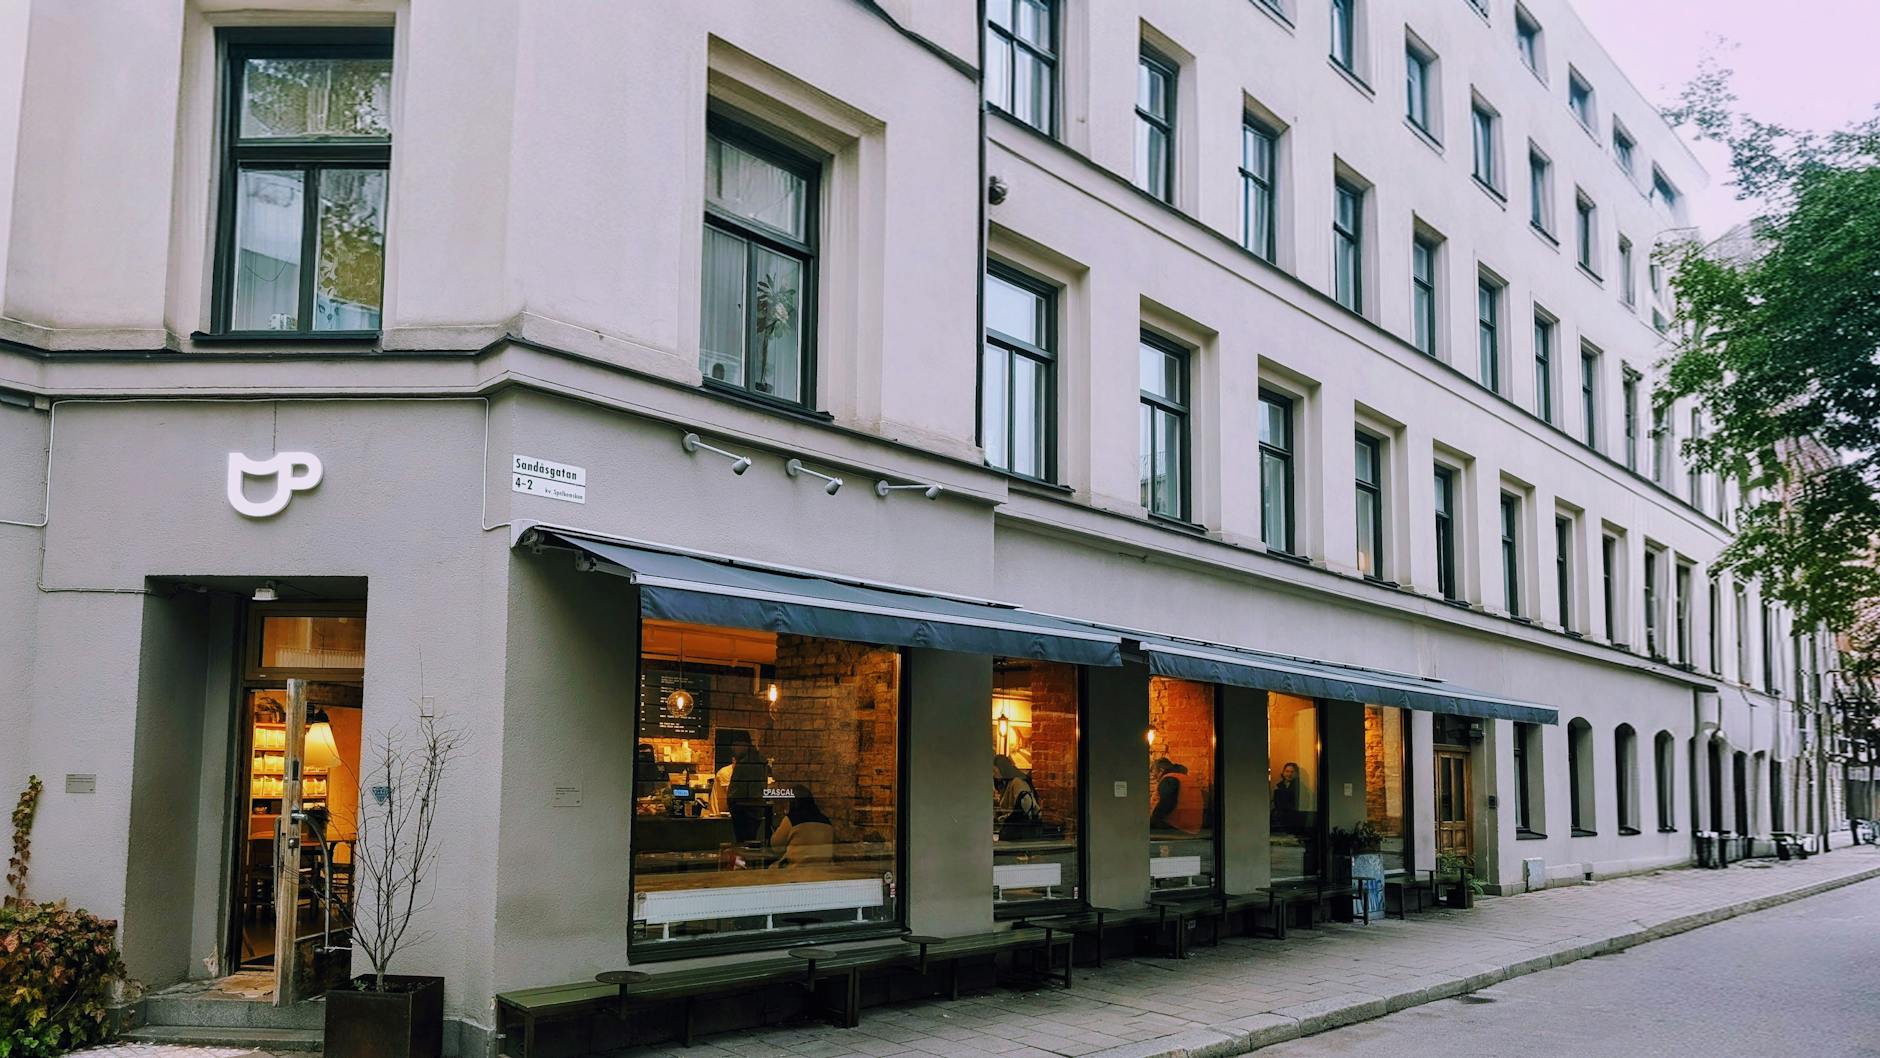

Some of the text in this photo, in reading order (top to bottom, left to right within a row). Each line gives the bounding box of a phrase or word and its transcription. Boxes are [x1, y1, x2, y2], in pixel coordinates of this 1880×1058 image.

[515, 458, 577, 480] Sandåsgatan
[515, 477, 533, 490] 4-2
[767, 788, 794, 796] PASCAL
